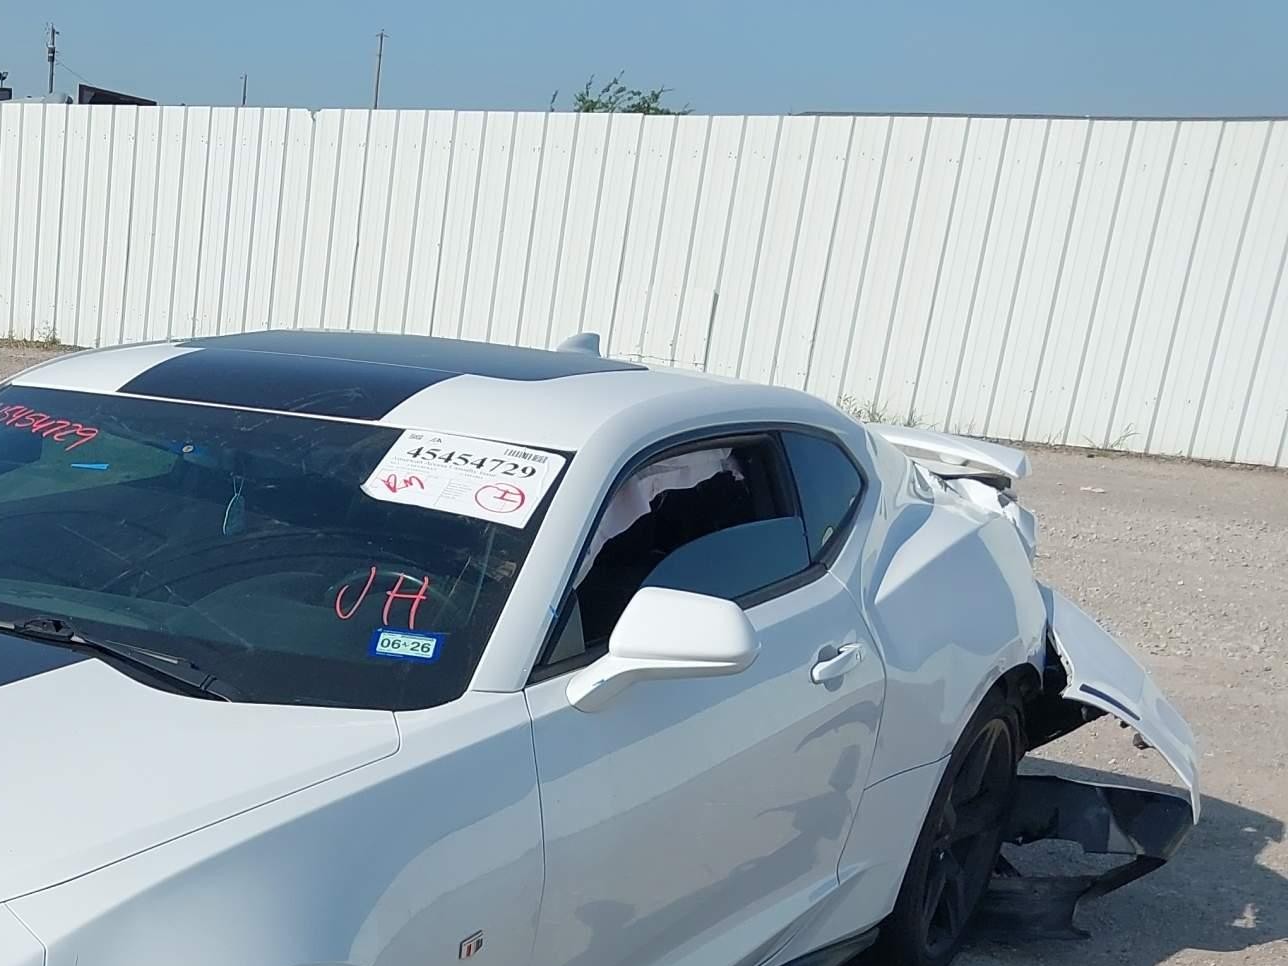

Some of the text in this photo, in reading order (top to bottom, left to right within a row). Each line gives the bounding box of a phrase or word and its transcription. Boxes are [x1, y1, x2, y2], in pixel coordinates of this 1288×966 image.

[406, 446, 537, 479] 45454729
[380, 637, 431, 654] 06 26
